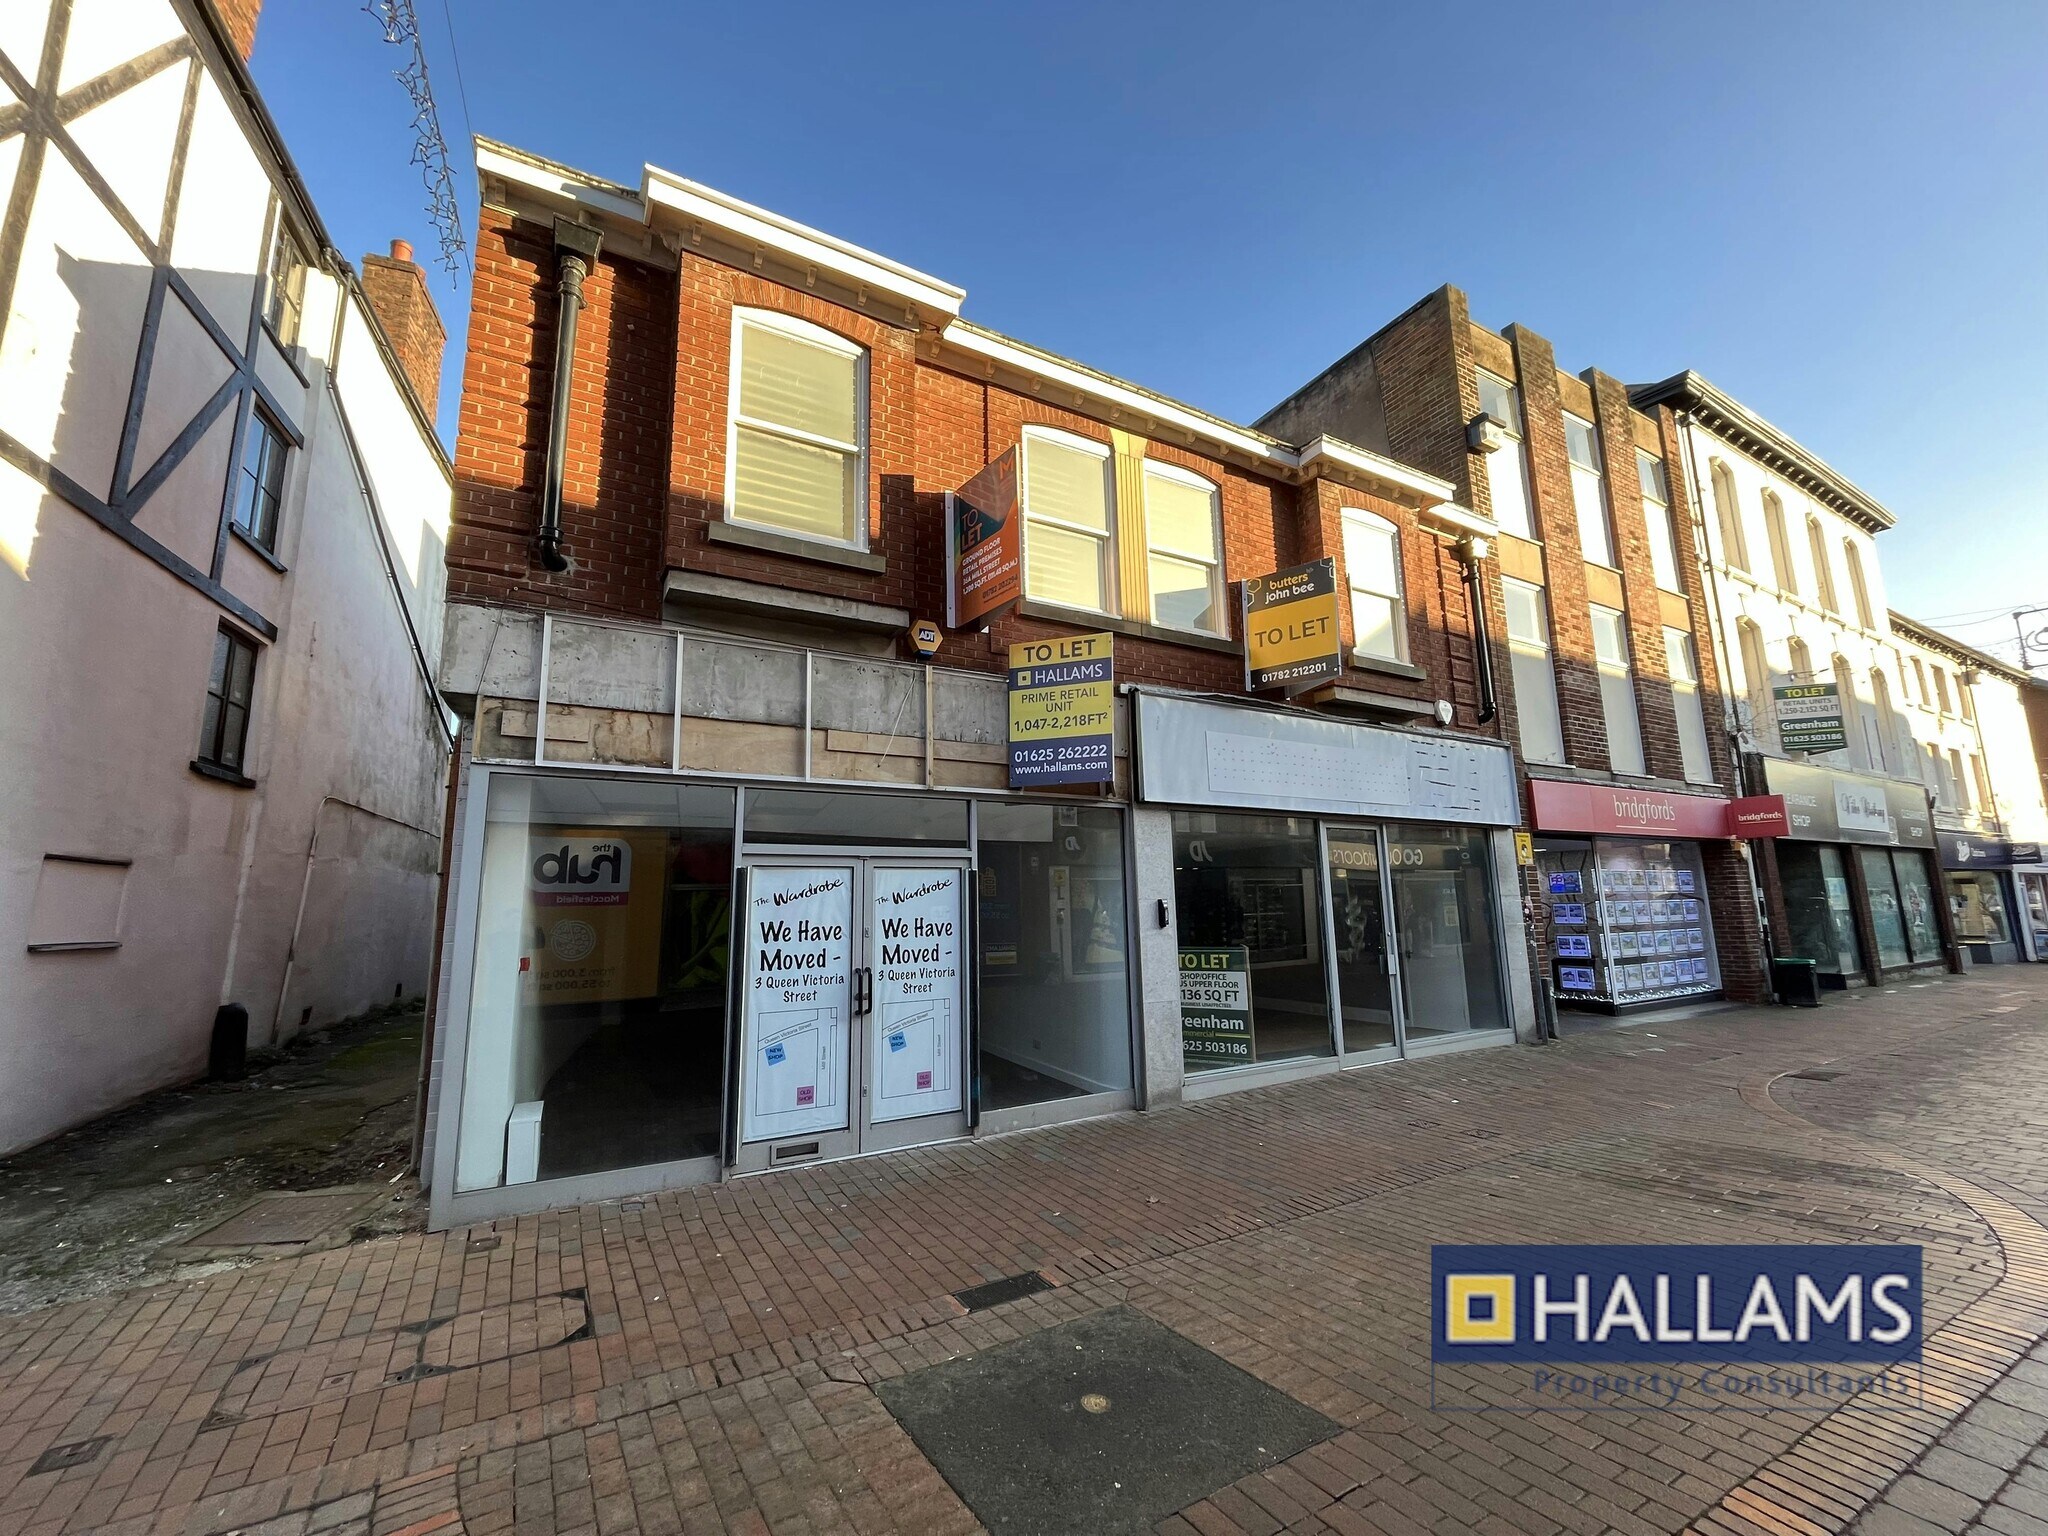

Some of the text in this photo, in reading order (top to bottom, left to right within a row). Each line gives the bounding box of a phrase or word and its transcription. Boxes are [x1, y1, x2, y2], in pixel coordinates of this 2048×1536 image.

[962, 509, 978, 527] TO
[962, 522, 982, 550] LET
[963, 537, 1000, 566] GROUND FLOOR
[963, 546, 1002, 576] RETAIL PREMISES
[972, 569, 982, 579] MILL
[983, 557, 1000, 573] STREET
[1269, 573, 1309, 590] butters
[1265, 582, 1315, 605] john bee
[919, 630, 935, 641] ADT
[1255, 616, 1329, 647] TO LET
[1024, 639, 1096, 662] TO LET
[1035, 663, 1103, 684] HALLAMS
[1262, 662, 1327, 683] 01782 212201
[1021, 687, 1099, 704] PRIME RETAIL
[1784, 687, 1826, 698] TO LET
[1046, 701, 1073, 713] UNIT
[1781, 720, 1839, 730] Greenham
[1014, 744, 1107, 763] 01625 262222
[1015, 760, 1108, 774] www.hallams.com
[1613, 795, 1676, 824] bridgfords
[1738, 811, 1783, 821] bridgfords
[1792, 814, 1811, 827] SHOP
[753, 879, 843, 907] The Wardrobe
[875, 879, 953, 905] The Wardrobe
[760, 920, 842, 944] We Have
[881, 917, 953, 939] We Have
[760, 948, 826, 971] Moved
[882, 943, 939, 965] Moved
[1178, 954, 1230, 969] TO LET
[755, 973, 844, 989] 3 Queen Victoria
[878, 966, 955, 981] 3 Queen Victoria
[783, 990, 817, 1003] Street
[902, 982, 933, 994] Street
[1181, 989, 1239, 1002] 136 SQ FT
[1182, 1015, 1244, 1030] eenham
[764, 1022, 812, 1044] Queen Victoria Street
[1183, 1040, 1248, 1055] 625 503186
